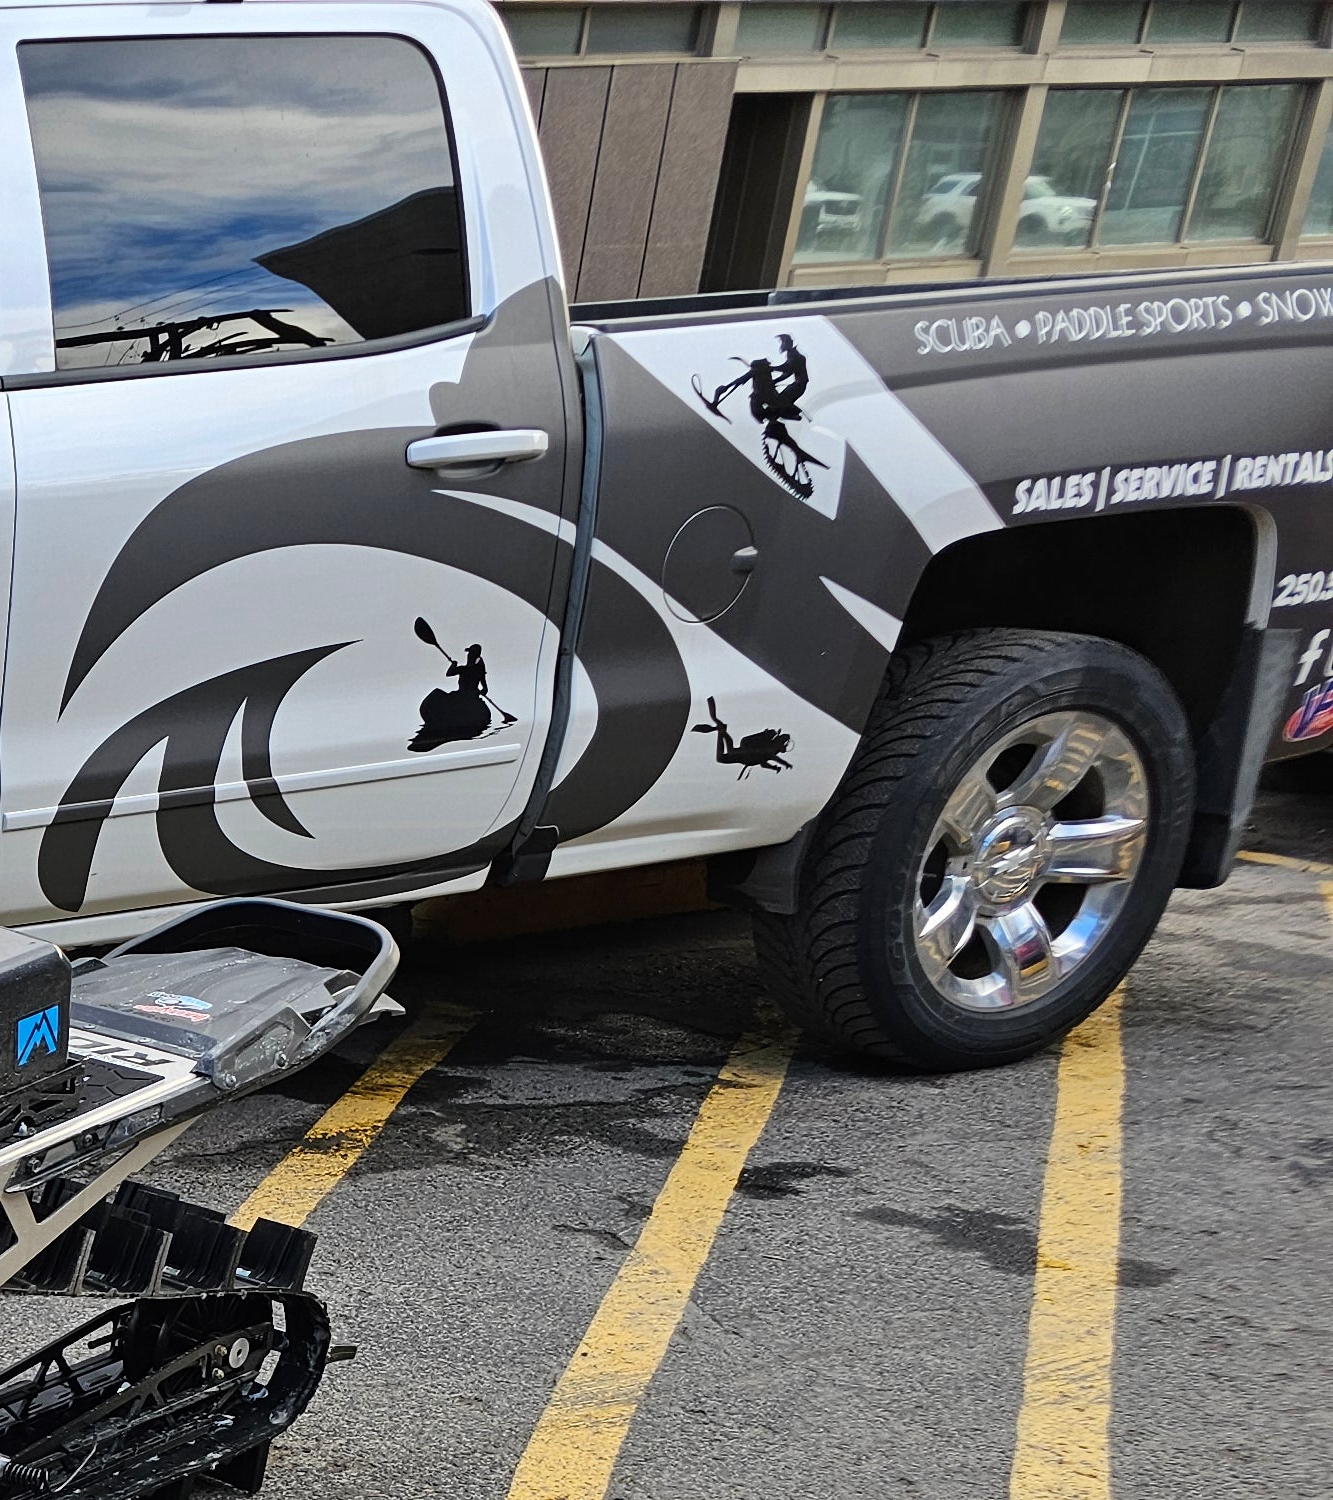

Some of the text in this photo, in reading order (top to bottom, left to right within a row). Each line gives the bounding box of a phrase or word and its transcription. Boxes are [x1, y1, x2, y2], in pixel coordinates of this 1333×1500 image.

[914, 314, 1012, 354] SCUBA
[1035, 303, 1136, 344] PADDLE
[1135, 295, 1233, 337] SPORTS
[1012, 471, 1096, 515] SALES
[1110, 460, 1216, 504] SERVICE
